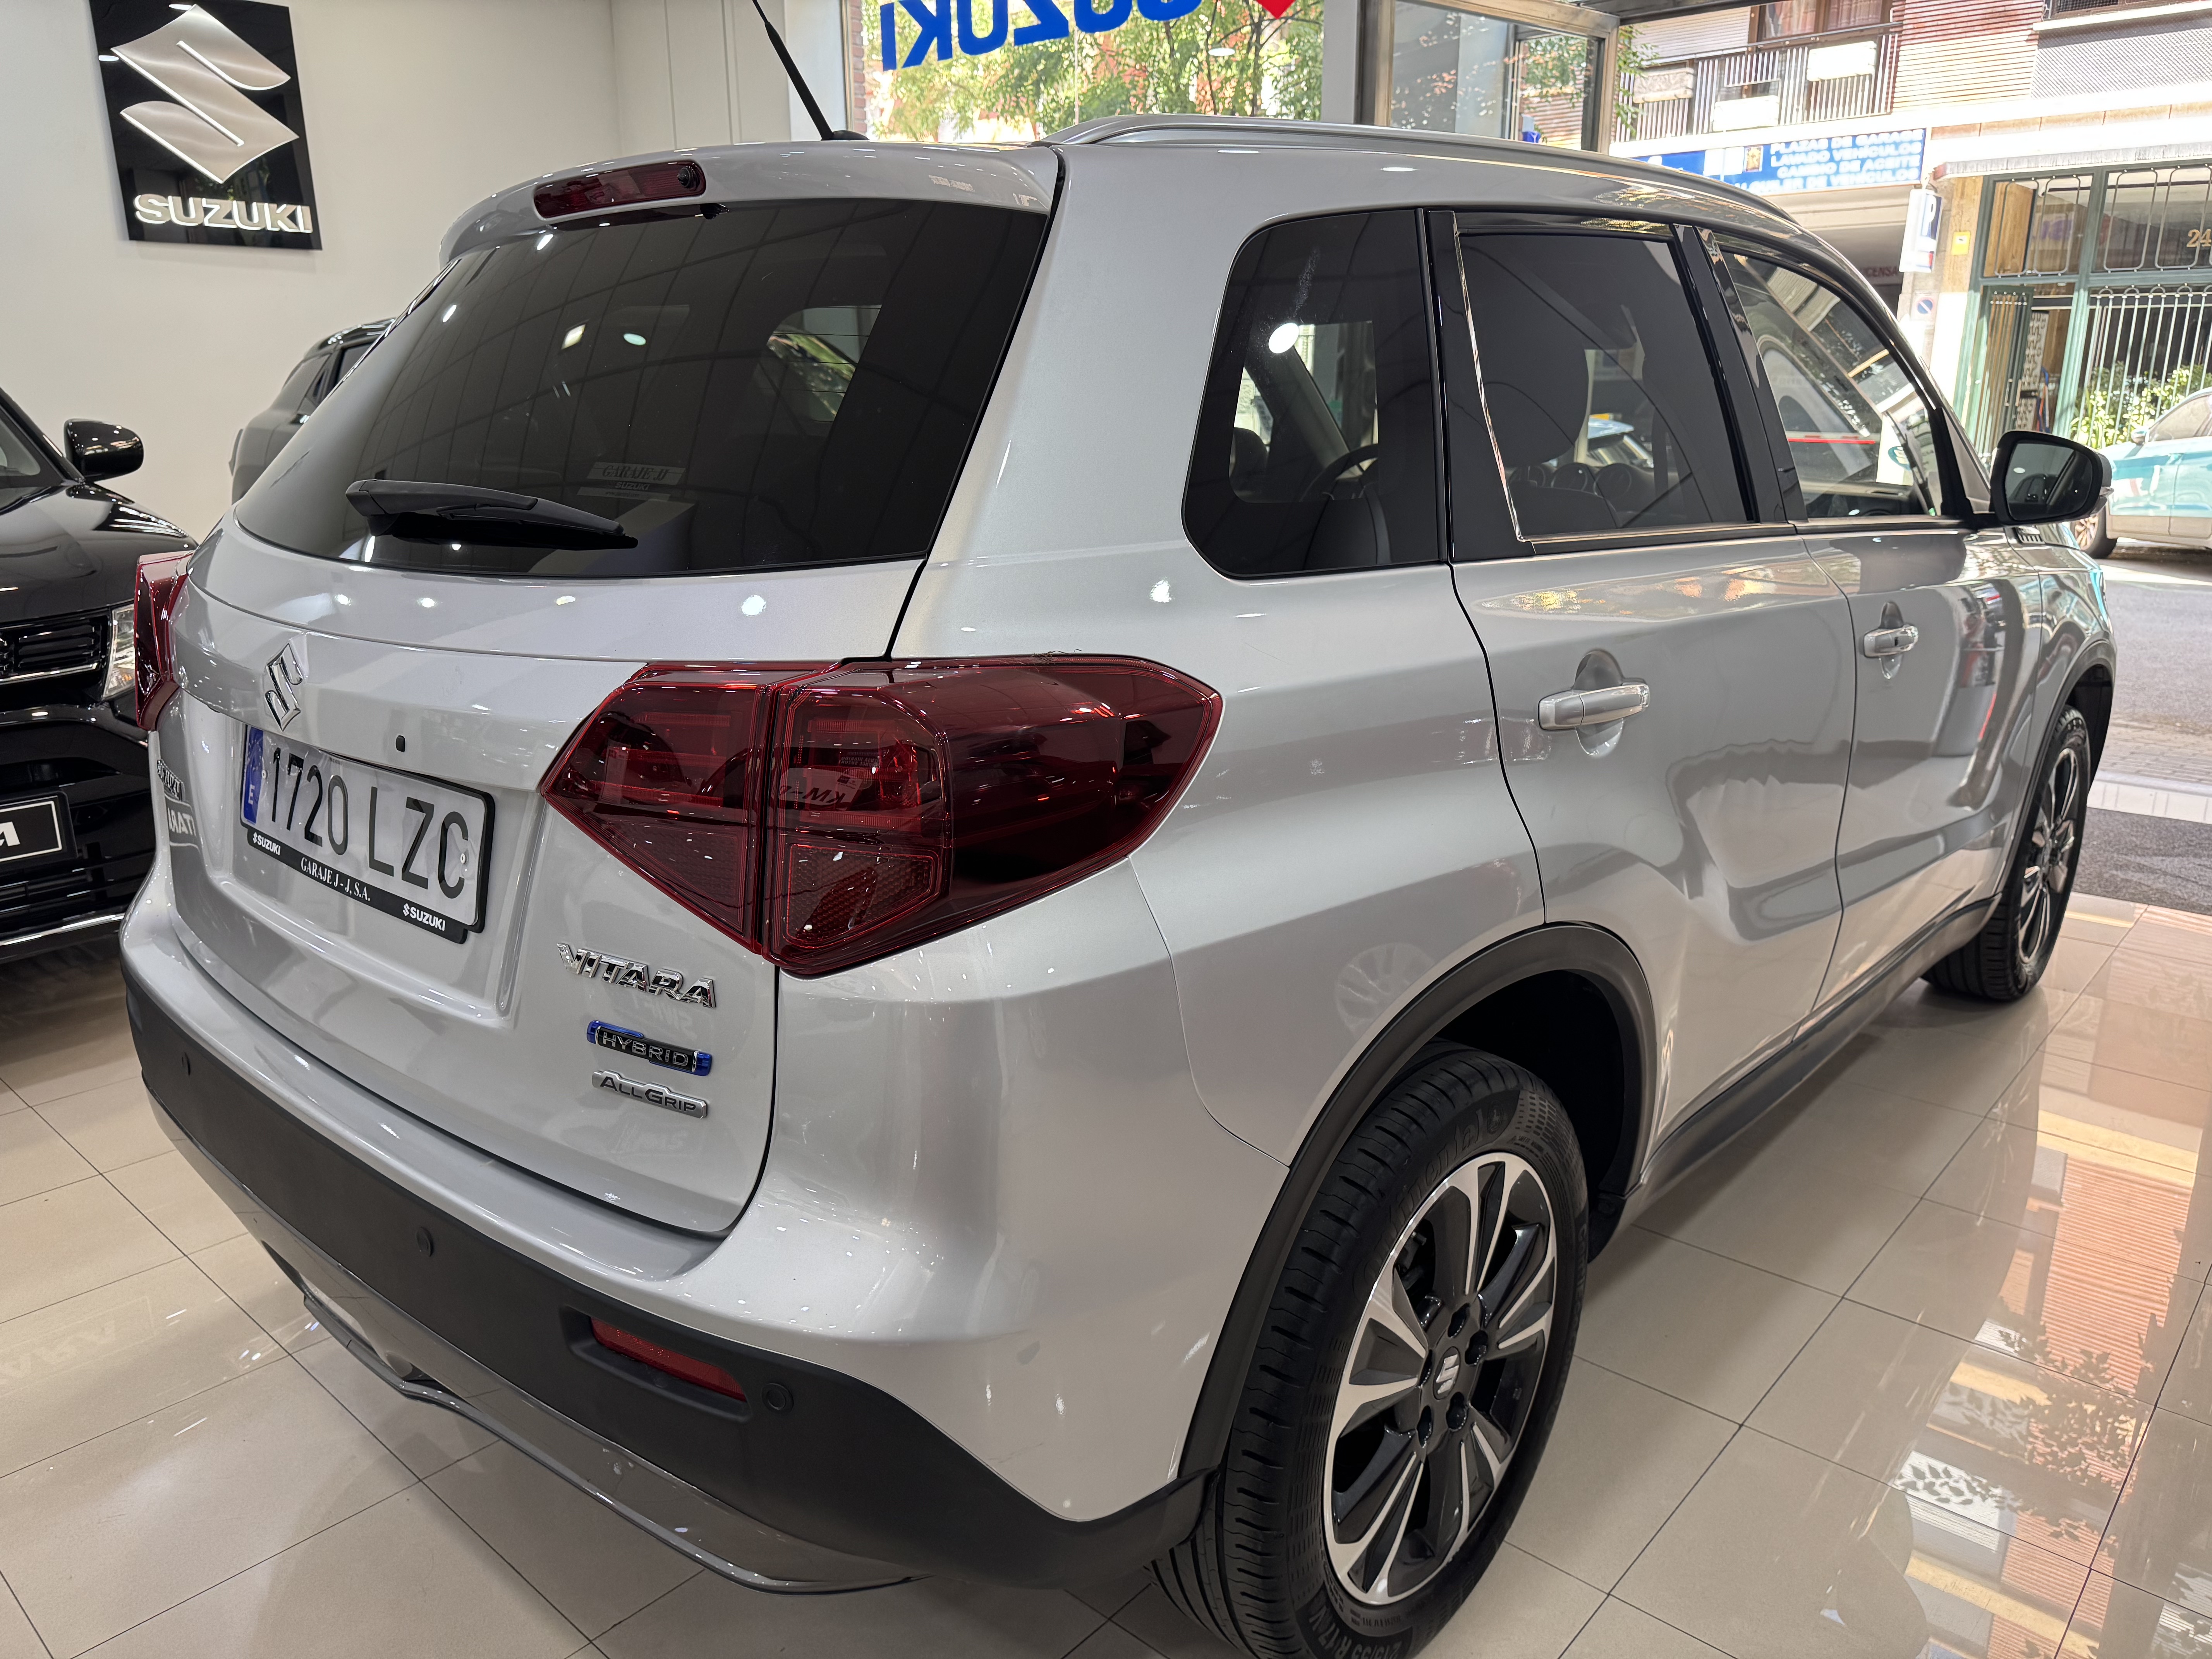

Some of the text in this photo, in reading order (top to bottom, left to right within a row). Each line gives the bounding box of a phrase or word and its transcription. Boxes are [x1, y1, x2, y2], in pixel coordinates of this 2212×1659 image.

[1771, 139, 1828, 154] PLAZAS
[1831, 136, 1852, 148] DE
[1771, 151, 1830, 167] LAVADO
[1778, 155, 1920, 178] CAMBIO DE ACEITE
[1807, 176, 1827, 188] DE
[134, 194, 313, 233] SUZUKI
[2186, 228, 2212, 247] 24
[602, 465, 654, 479] GARAJE
[615, 482, 650, 491] SUZUKI
[248, 784, 254, 805] E
[271, 747, 469, 899] 1720 LZC
[258, 835, 281, 856] SUZUKI
[301, 857, 333, 884] GARAJE
[354, 882, 371, 902] S.A.
[410, 907, 446, 931] SUZUKI
[556, 943, 716, 1008] VITARA
[603, 1032, 689, 1067] HYBRID
